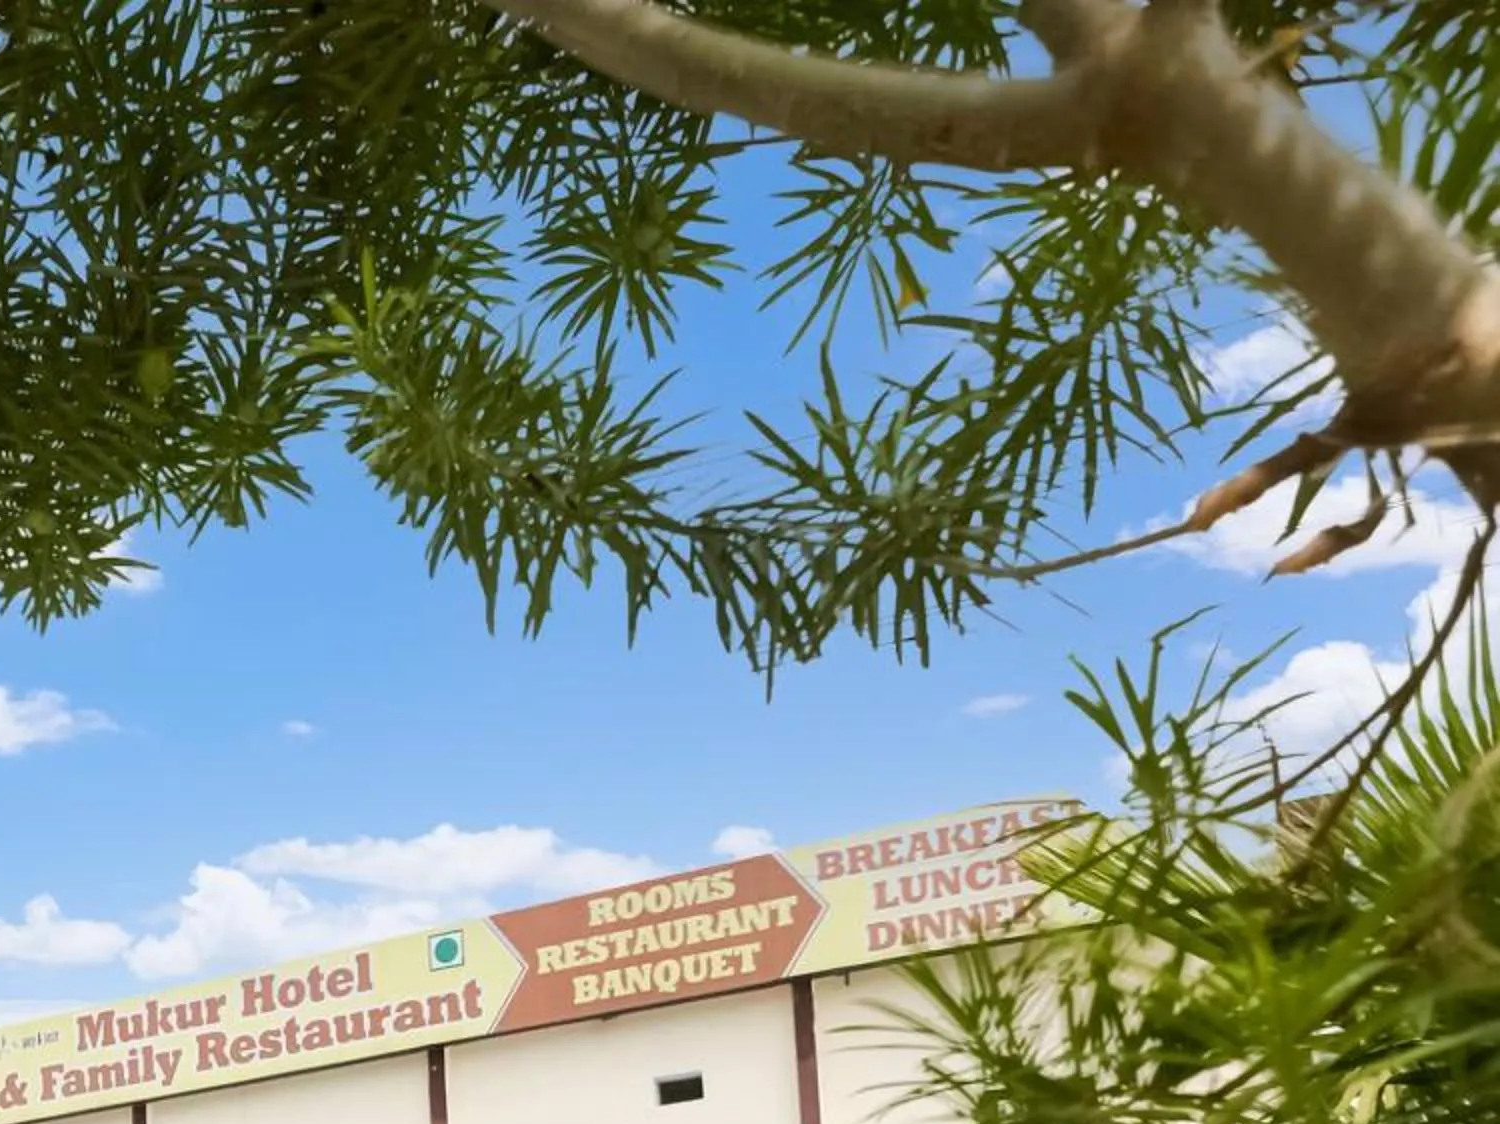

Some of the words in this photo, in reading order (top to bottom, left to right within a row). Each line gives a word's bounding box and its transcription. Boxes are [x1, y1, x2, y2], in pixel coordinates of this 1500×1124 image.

[816, 802, 1083, 880] BREAKFAST
[536, 896, 798, 975] RESTAURANT
[587, 869, 736, 927] ROOMS
[76, 989, 227, 1052] Mukur
[240, 952, 373, 1018] Hotel
[572, 942, 762, 1005] BANQUET
[39, 1046, 182, 1102] Family
[195, 979, 484, 1072] Restaurant
